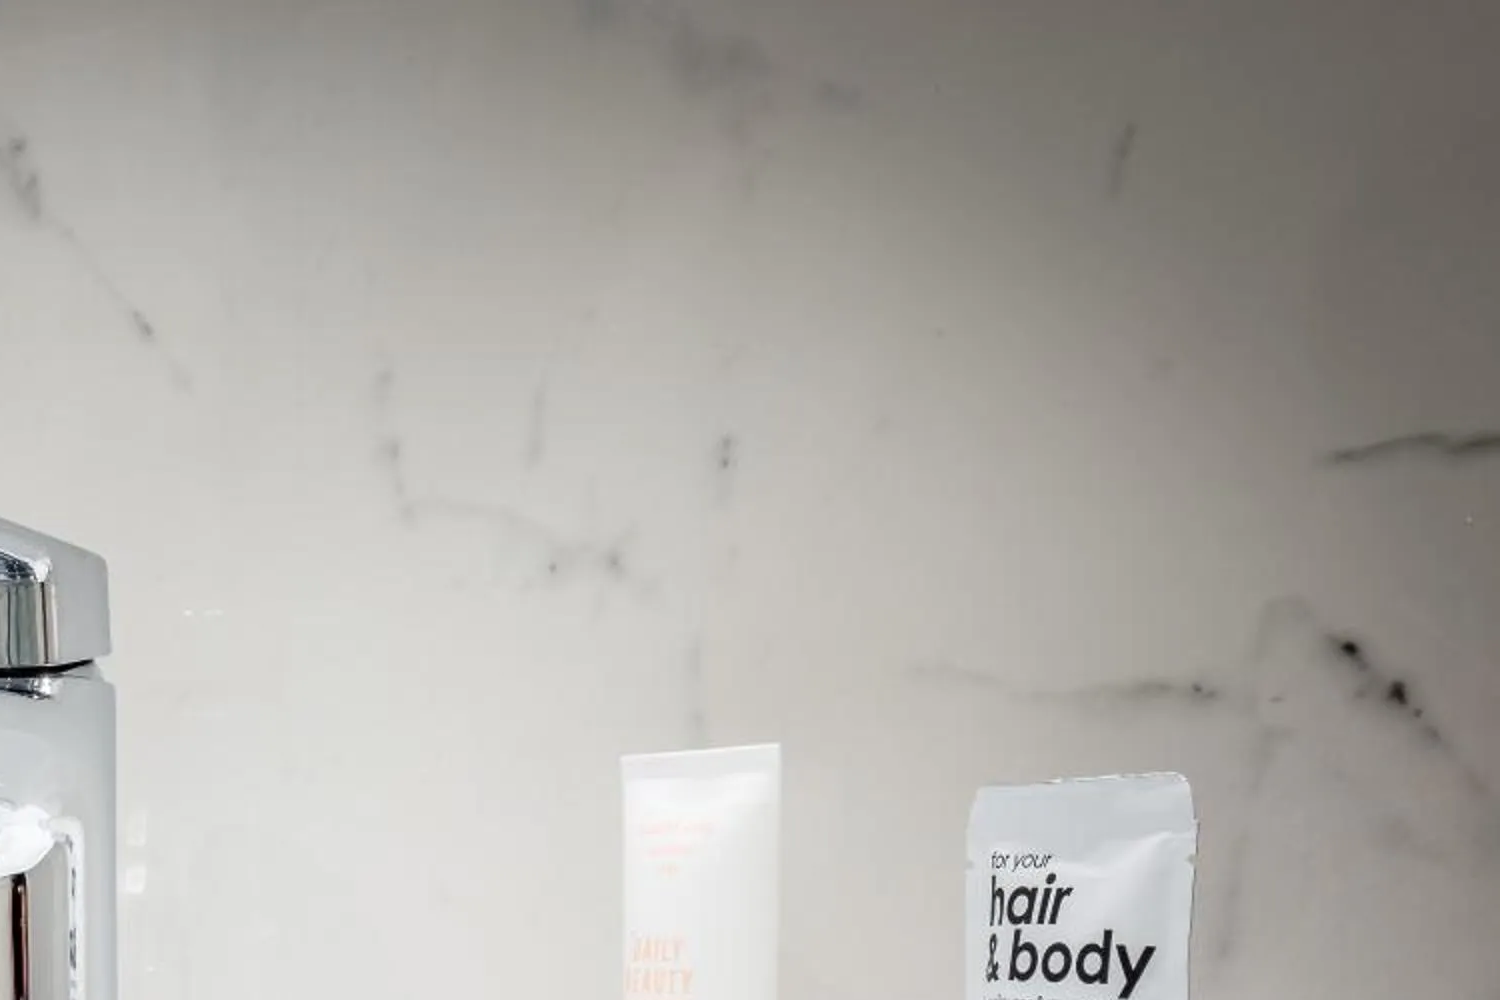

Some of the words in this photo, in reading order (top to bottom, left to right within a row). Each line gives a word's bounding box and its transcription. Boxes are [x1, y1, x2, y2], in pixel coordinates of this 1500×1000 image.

[991, 851, 1011, 870] for
[1012, 853, 1053, 872] your
[990, 872, 1074, 926] hair
[985, 932, 999, 983] &
[1008, 928, 1157, 1000] body
